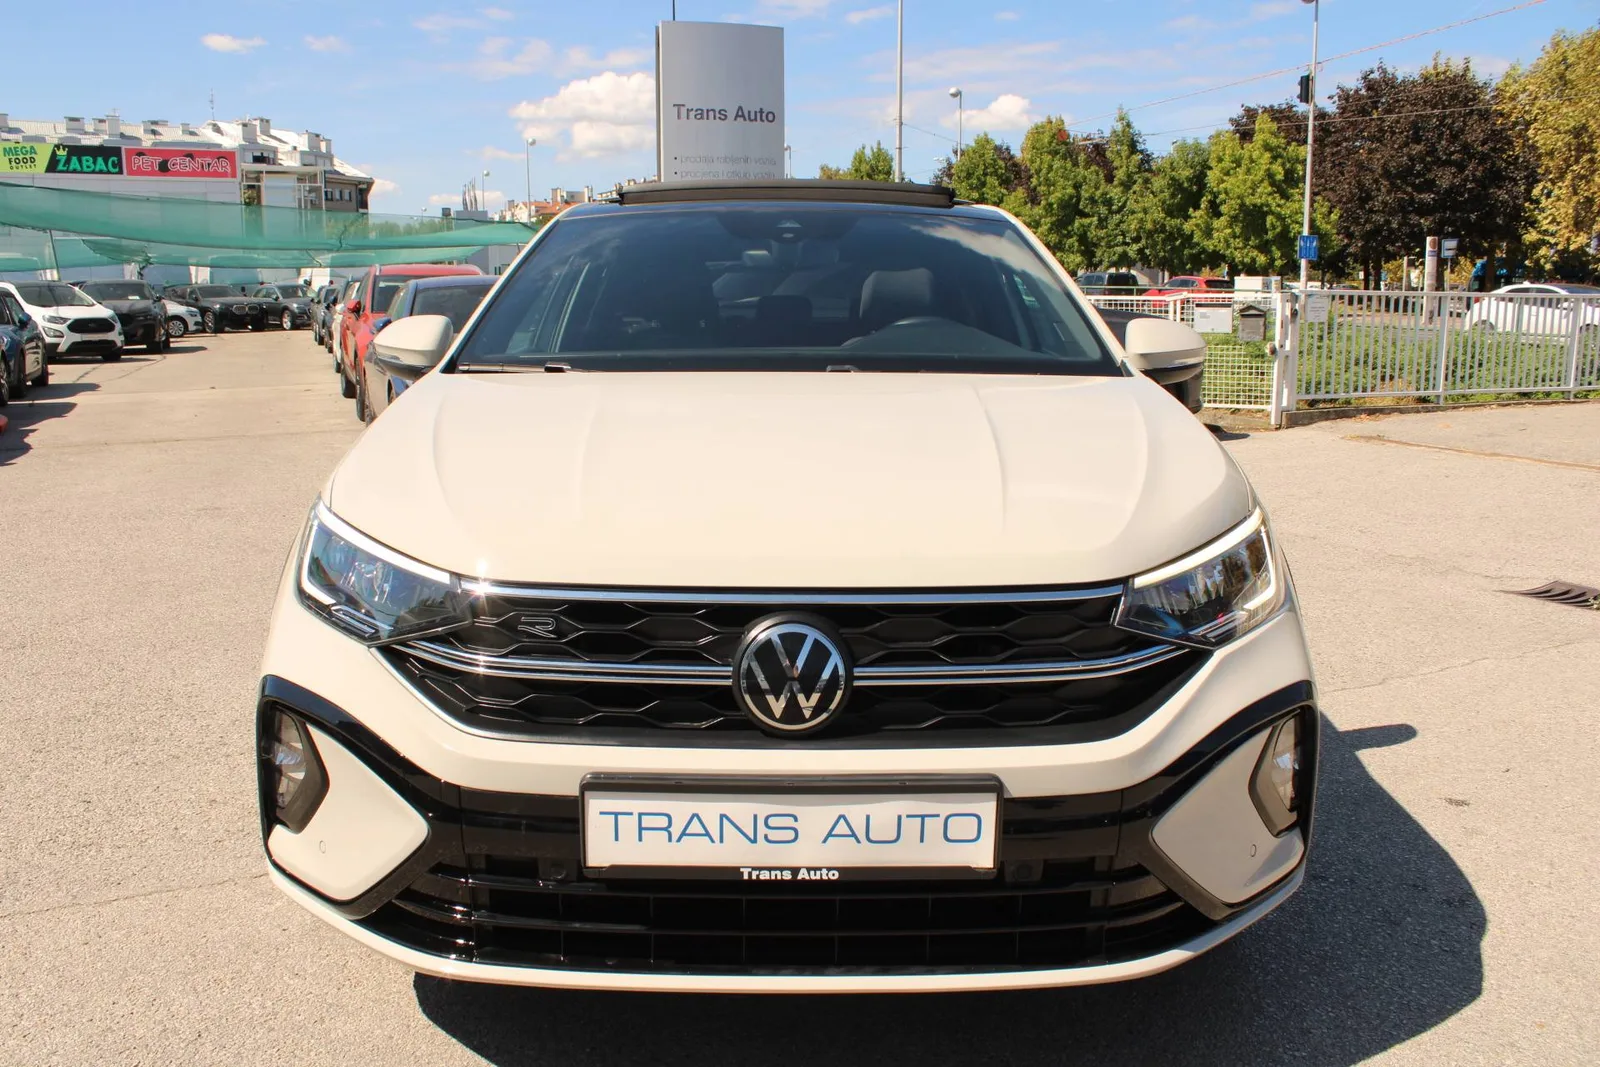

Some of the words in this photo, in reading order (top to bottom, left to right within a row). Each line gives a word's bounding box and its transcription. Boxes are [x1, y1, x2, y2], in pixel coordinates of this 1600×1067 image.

[673, 103, 728, 121] Trans
[733, 105, 776, 123] Auto
[3, 145, 38, 157] MEGA
[8, 156, 36, 165] FOOD
[131, 155, 162, 171] PET
[167, 156, 231, 173] CENTAR
[598, 811, 799, 845] TRANS
[821, 812, 983, 845] AUTO
[740, 867, 792, 881] Trans
[796, 867, 840, 881] Auto
